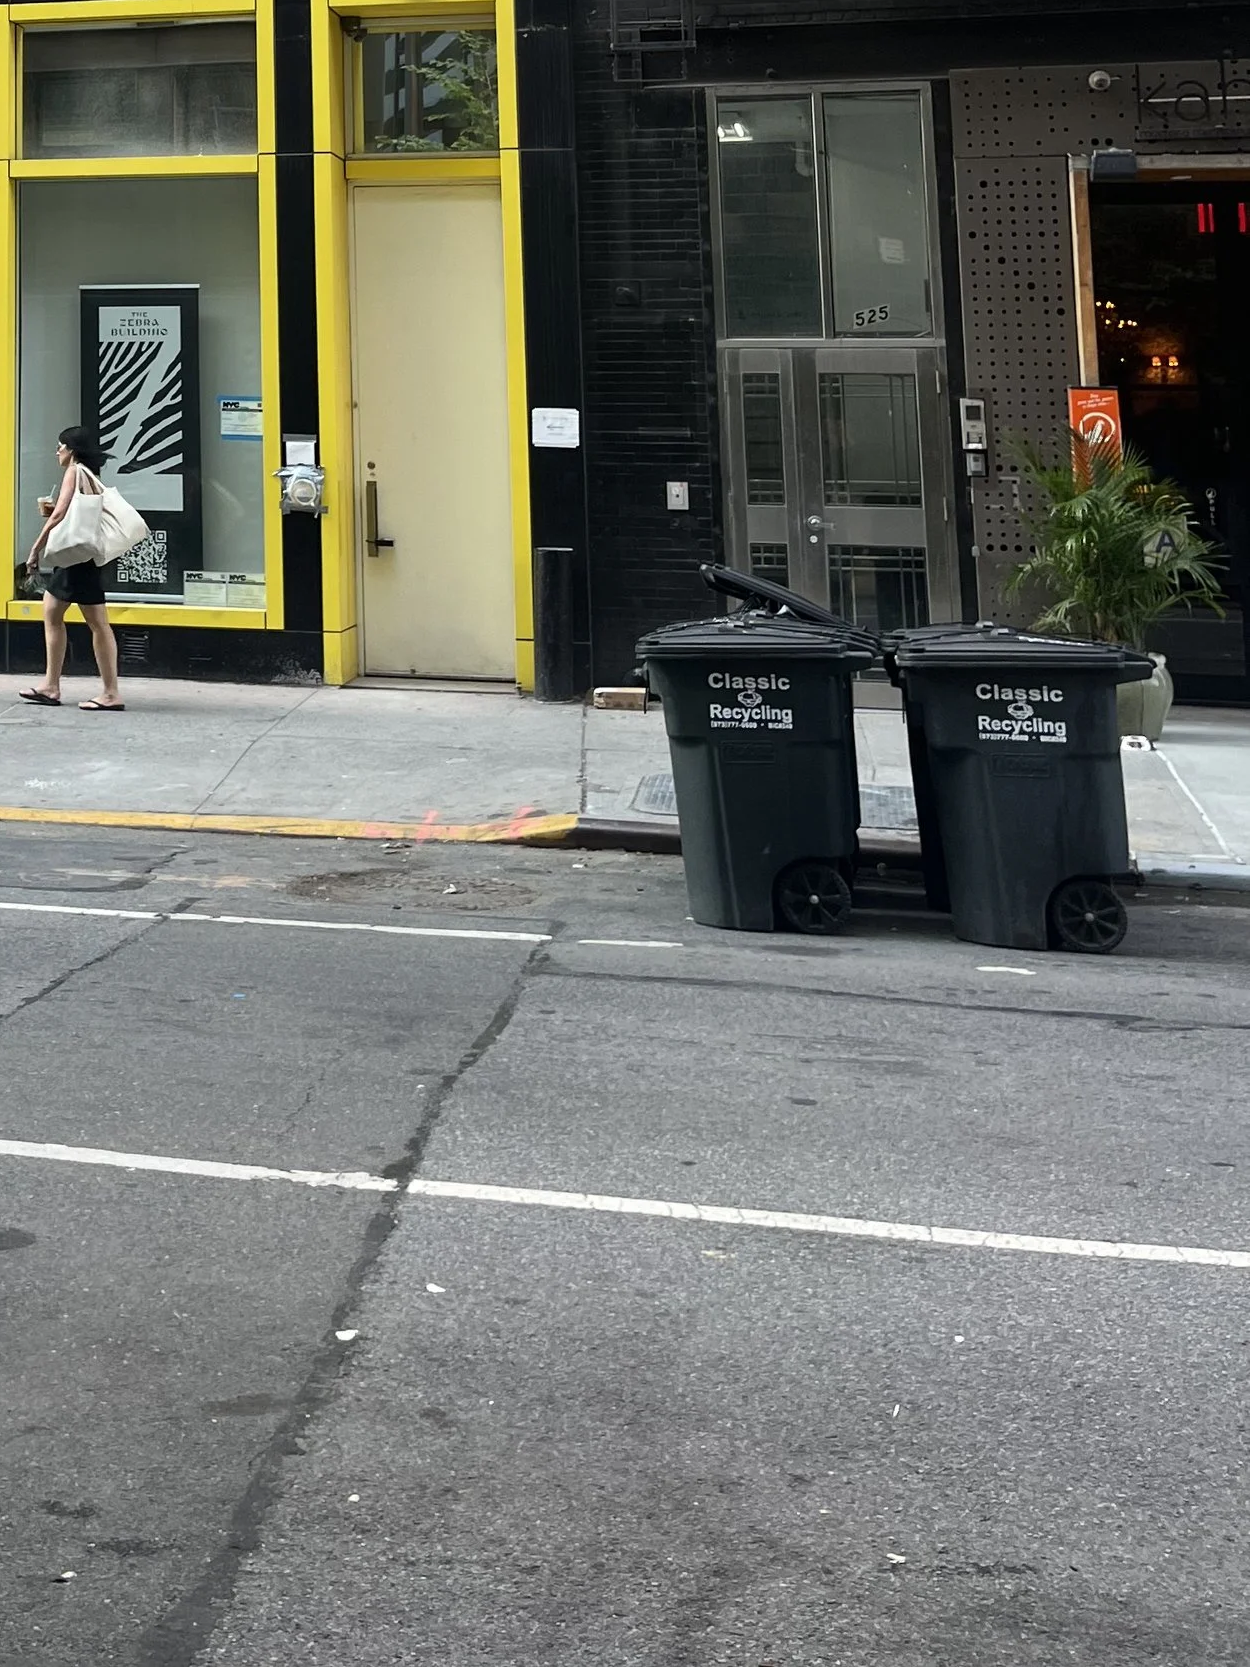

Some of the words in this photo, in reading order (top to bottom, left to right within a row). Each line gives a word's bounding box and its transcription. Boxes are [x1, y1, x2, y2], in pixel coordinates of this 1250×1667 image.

[119, 318, 160, 327] ZEBRA
[855, 305, 889, 327] 525
[111, 328, 169, 337] BUILDING
[1155, 530, 1178, 554] A
[707, 672, 791, 691] Classic
[975, 683, 1064, 703] Classic
[709, 703, 793, 724] Recycling
[977, 715, 1067, 737] Recycling
